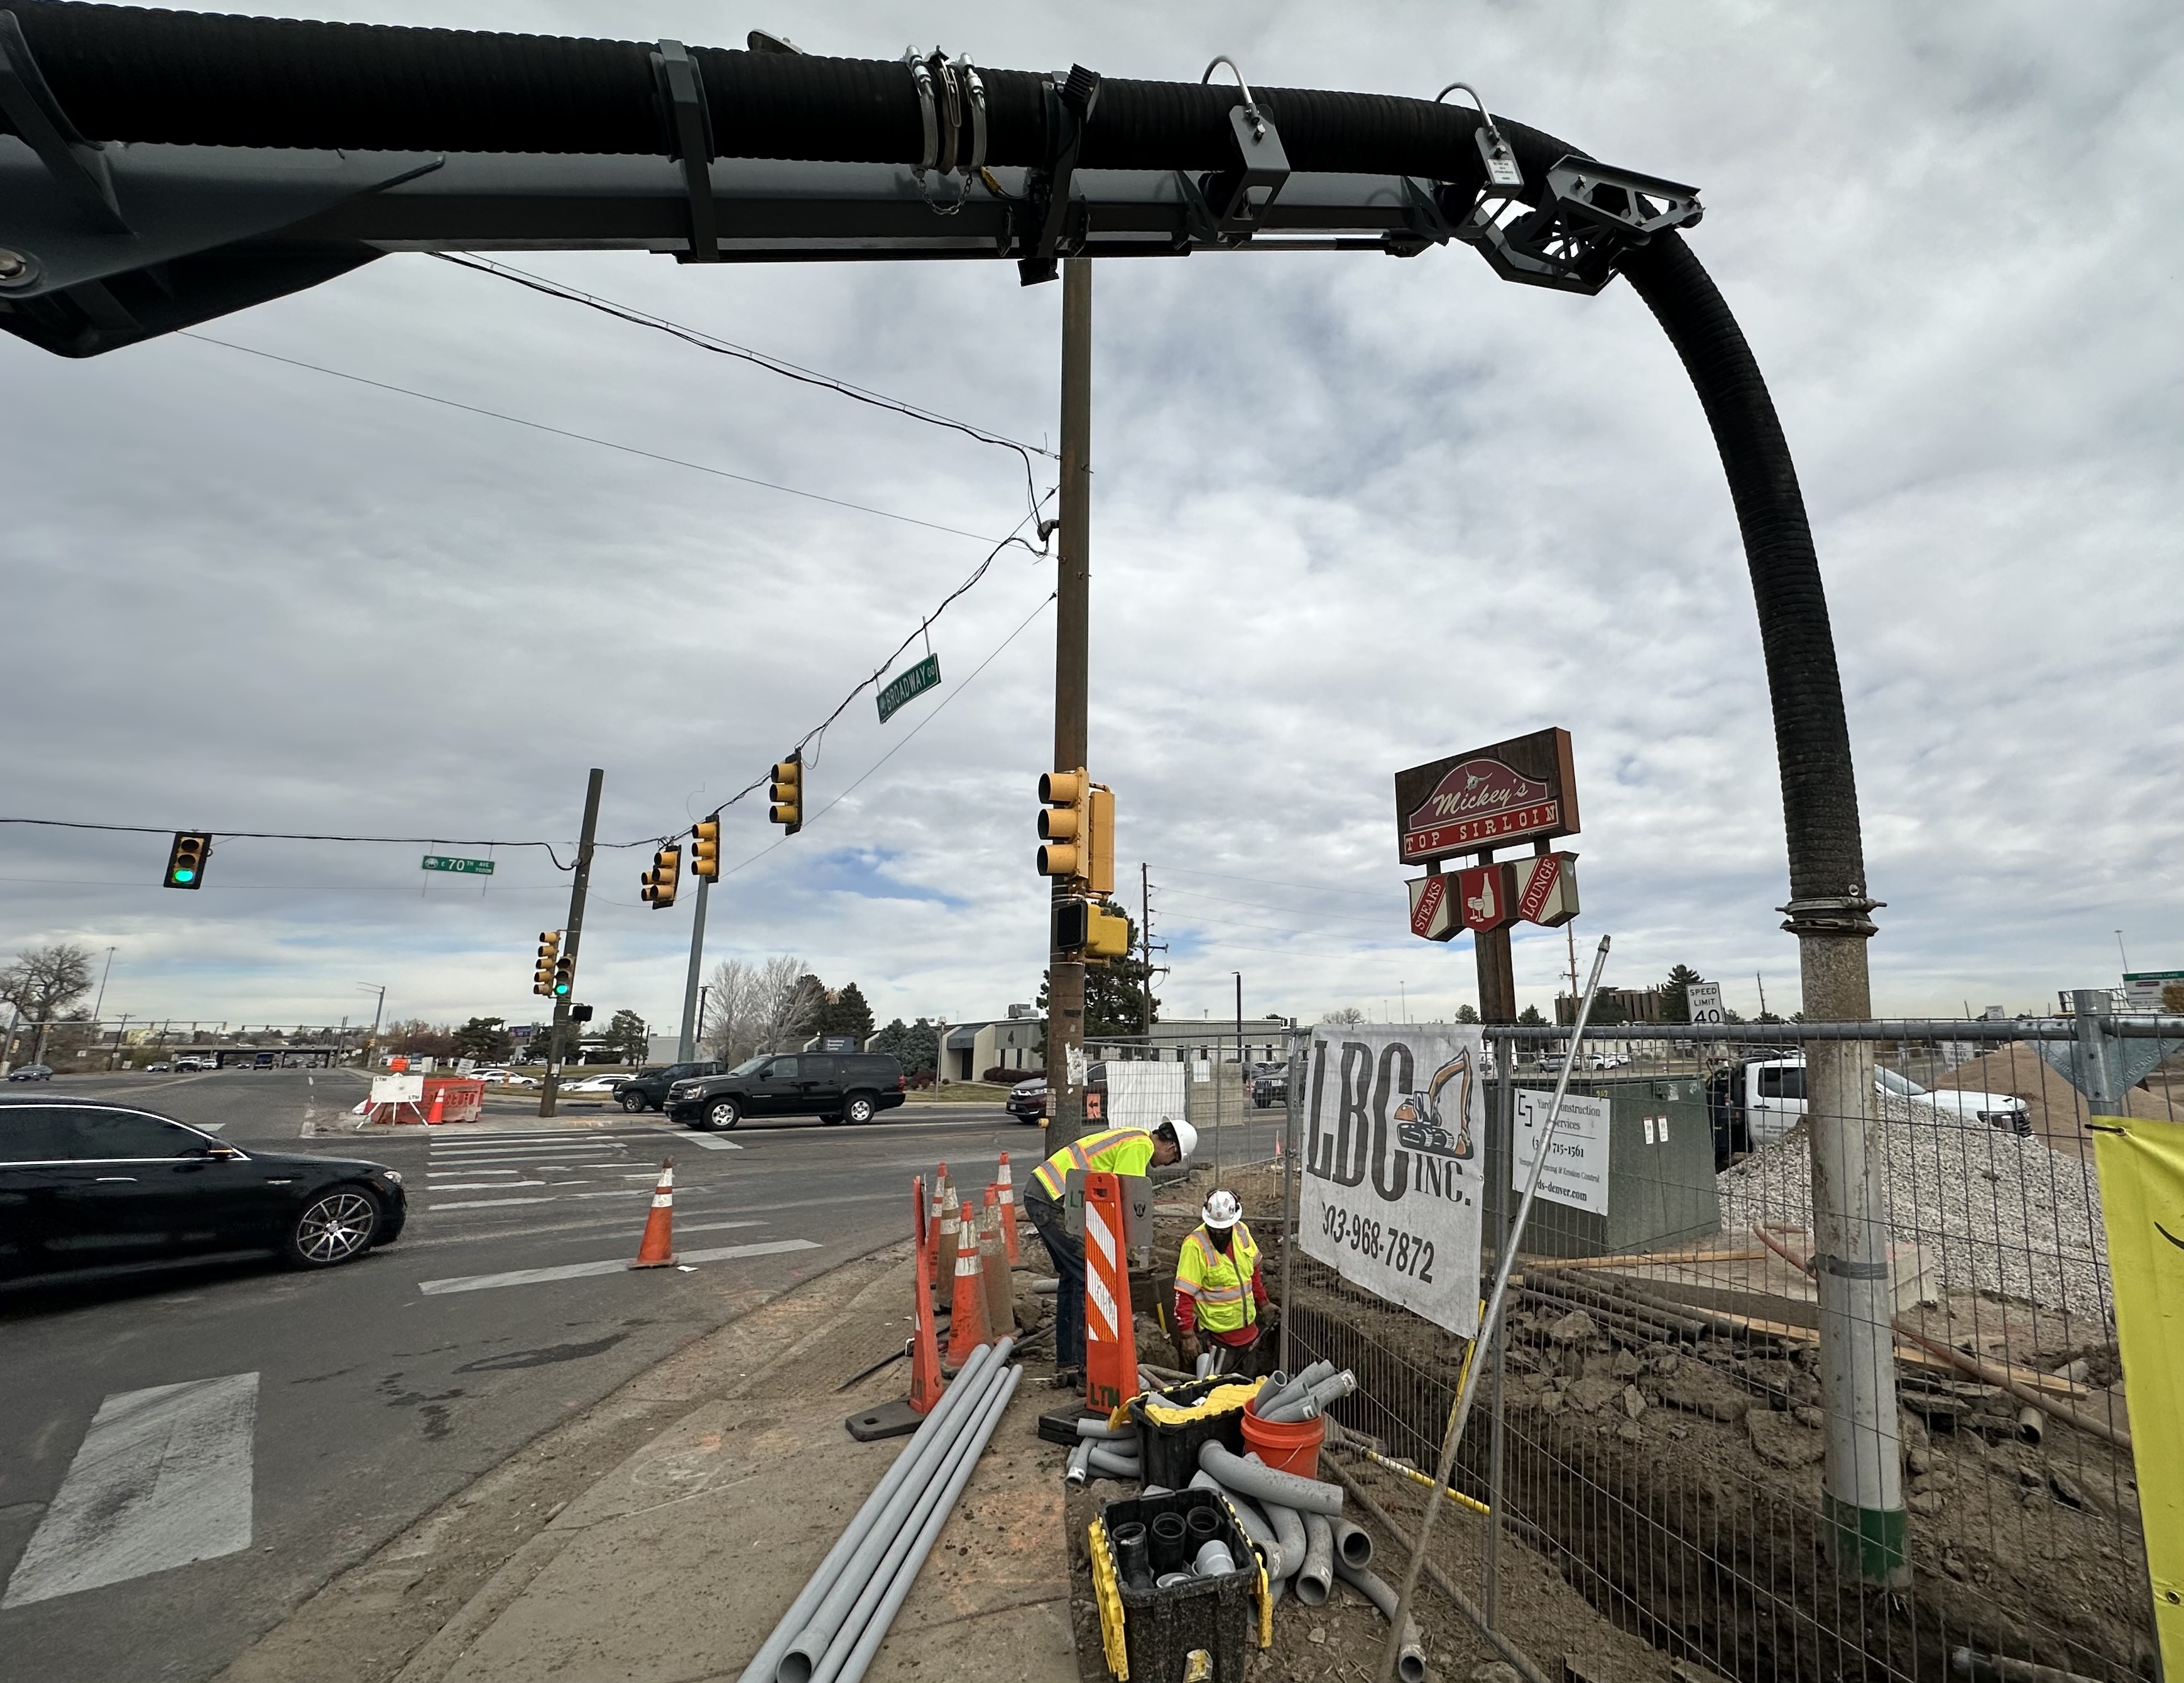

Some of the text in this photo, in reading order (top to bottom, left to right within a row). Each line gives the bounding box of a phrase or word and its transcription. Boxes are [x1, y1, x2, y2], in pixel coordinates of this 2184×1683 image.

[885, 665, 926, 711] BROADWAY
[1433, 778, 1528, 816] Mickey's
[1406, 805, 1556, 851] TOP SIRLOIN
[1522, 858, 1556, 918] LOUNGE
[1415, 881, 1441, 930] STEAKS
[1690, 987, 1717, 996] SPEED
[1694, 998, 1715, 1006] LIMIT
[1694, 1009, 1720, 1024] 40
[1008, 1030, 1014, 1044] 4
[1306, 1039, 1414, 1202] LBC
[1560, 1104, 1600, 1117] onstruction
[1554, 1118, 1581, 1131] ervices
[1532, 1135, 1584, 1158] (3) 715-1561
[1414, 1153, 1471, 1207] INC.
[1542, 1165, 1558, 1175] encing
[1070, 1189, 1085, 1208] LT
[1090, 1382, 1120, 1408] LTM
